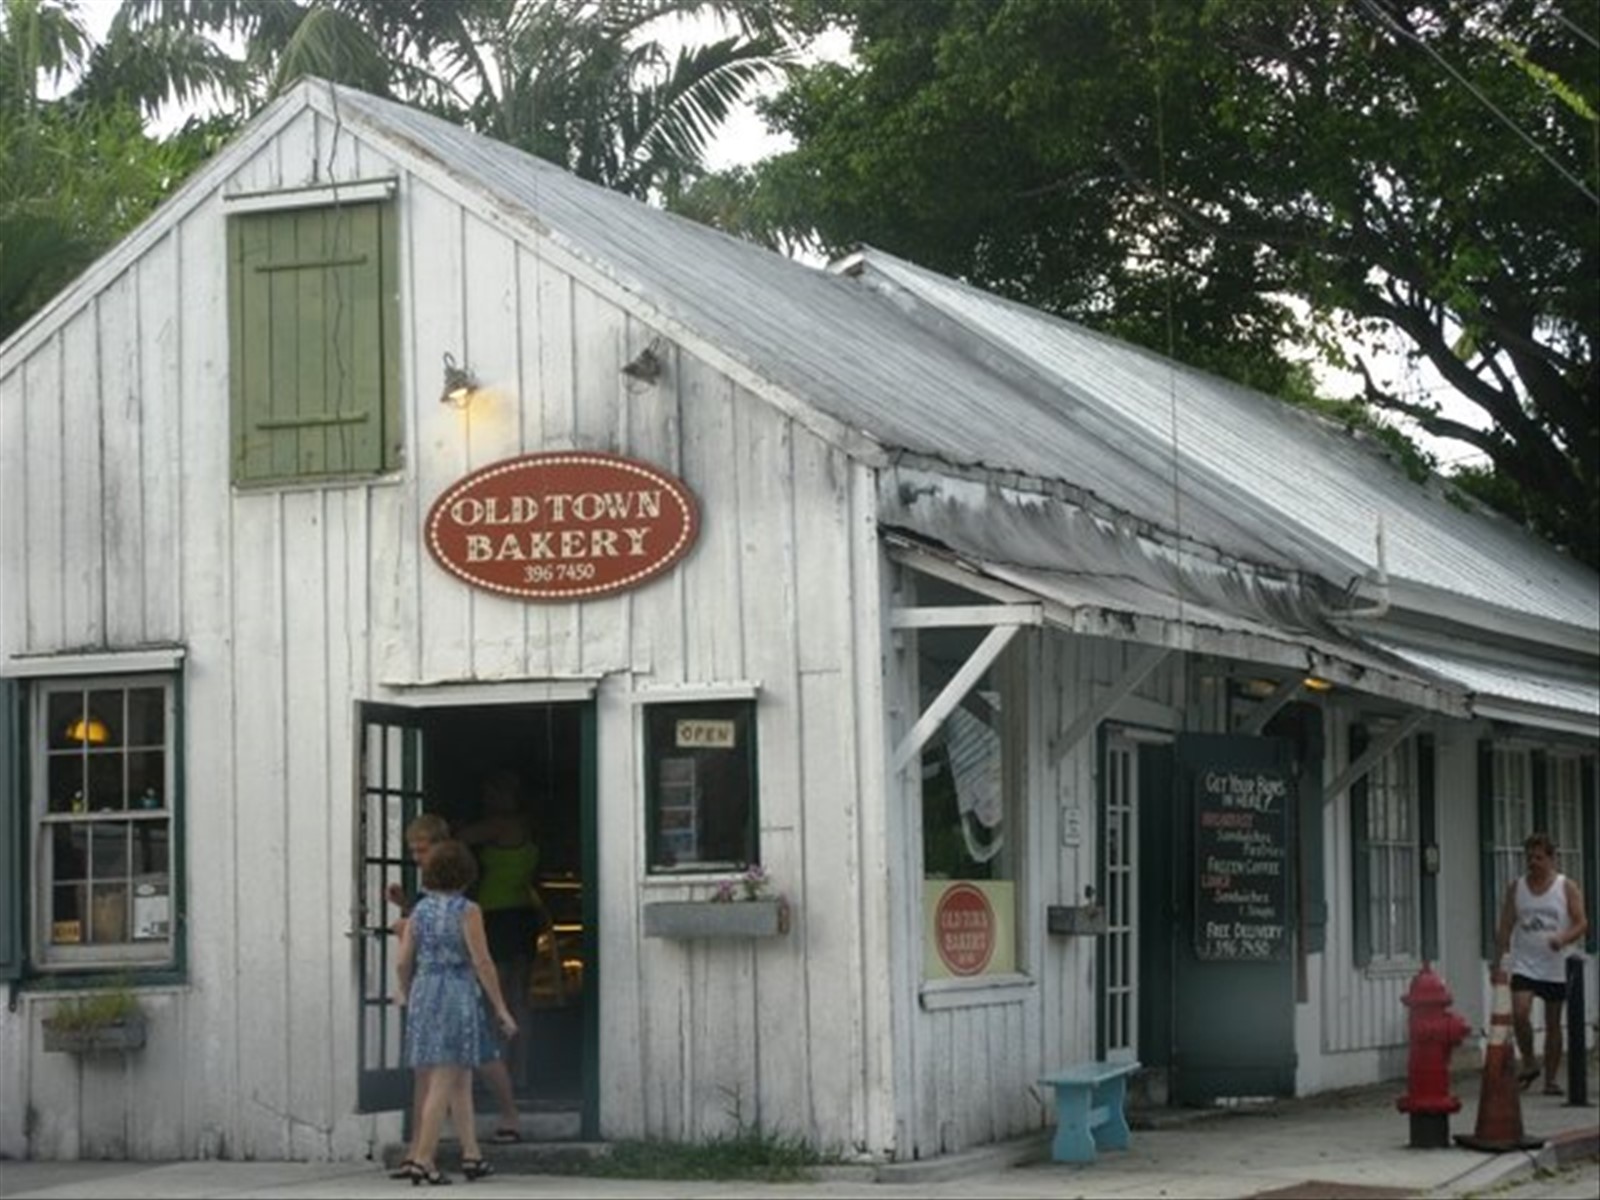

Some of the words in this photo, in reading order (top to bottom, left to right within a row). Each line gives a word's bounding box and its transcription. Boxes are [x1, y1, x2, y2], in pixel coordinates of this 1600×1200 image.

[451, 496, 538, 525] OLD
[545, 491, 662, 522] TOWN
[466, 527, 651, 562] BAKERY
[524, 565, 553, 583] 396
[557, 563, 596, 580] 7450
[681, 726, 729, 741] OPEN
